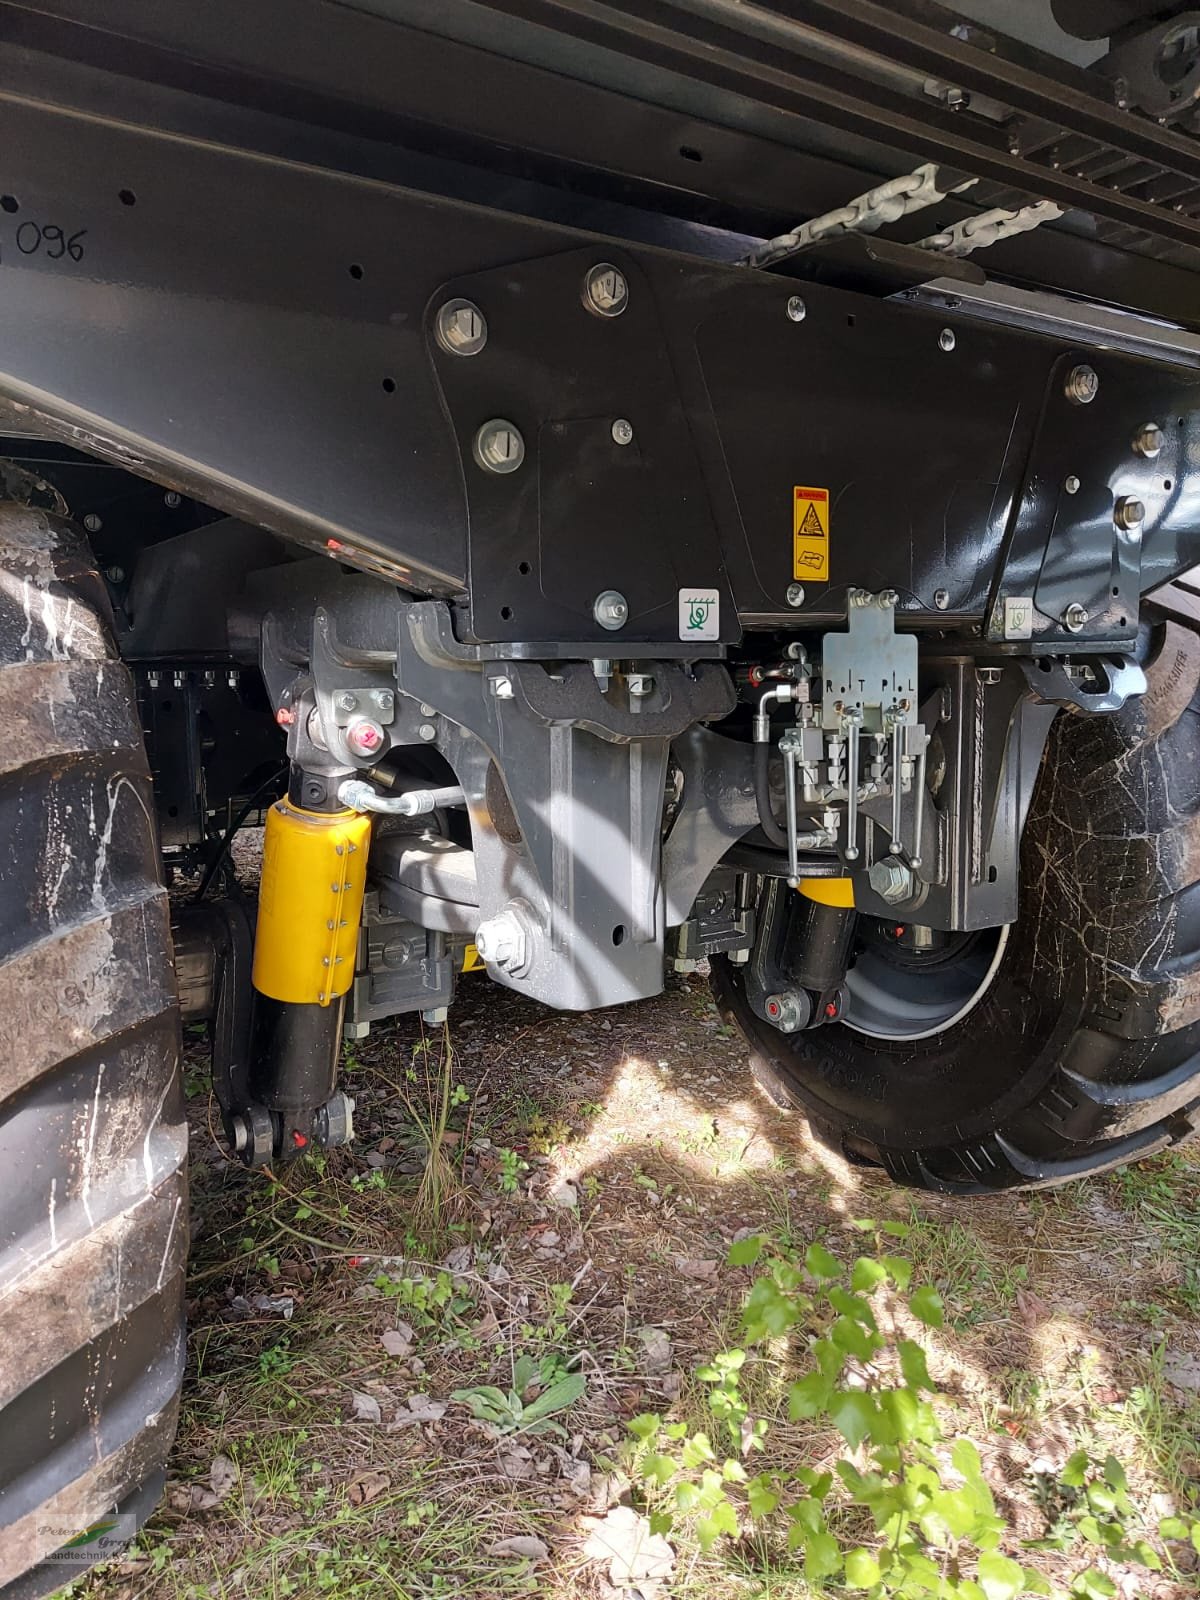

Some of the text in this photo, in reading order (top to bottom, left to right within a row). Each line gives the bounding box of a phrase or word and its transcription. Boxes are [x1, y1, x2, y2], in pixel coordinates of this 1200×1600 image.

[16, 221, 88, 262] 096
[826, 678, 914, 693] R T P L
